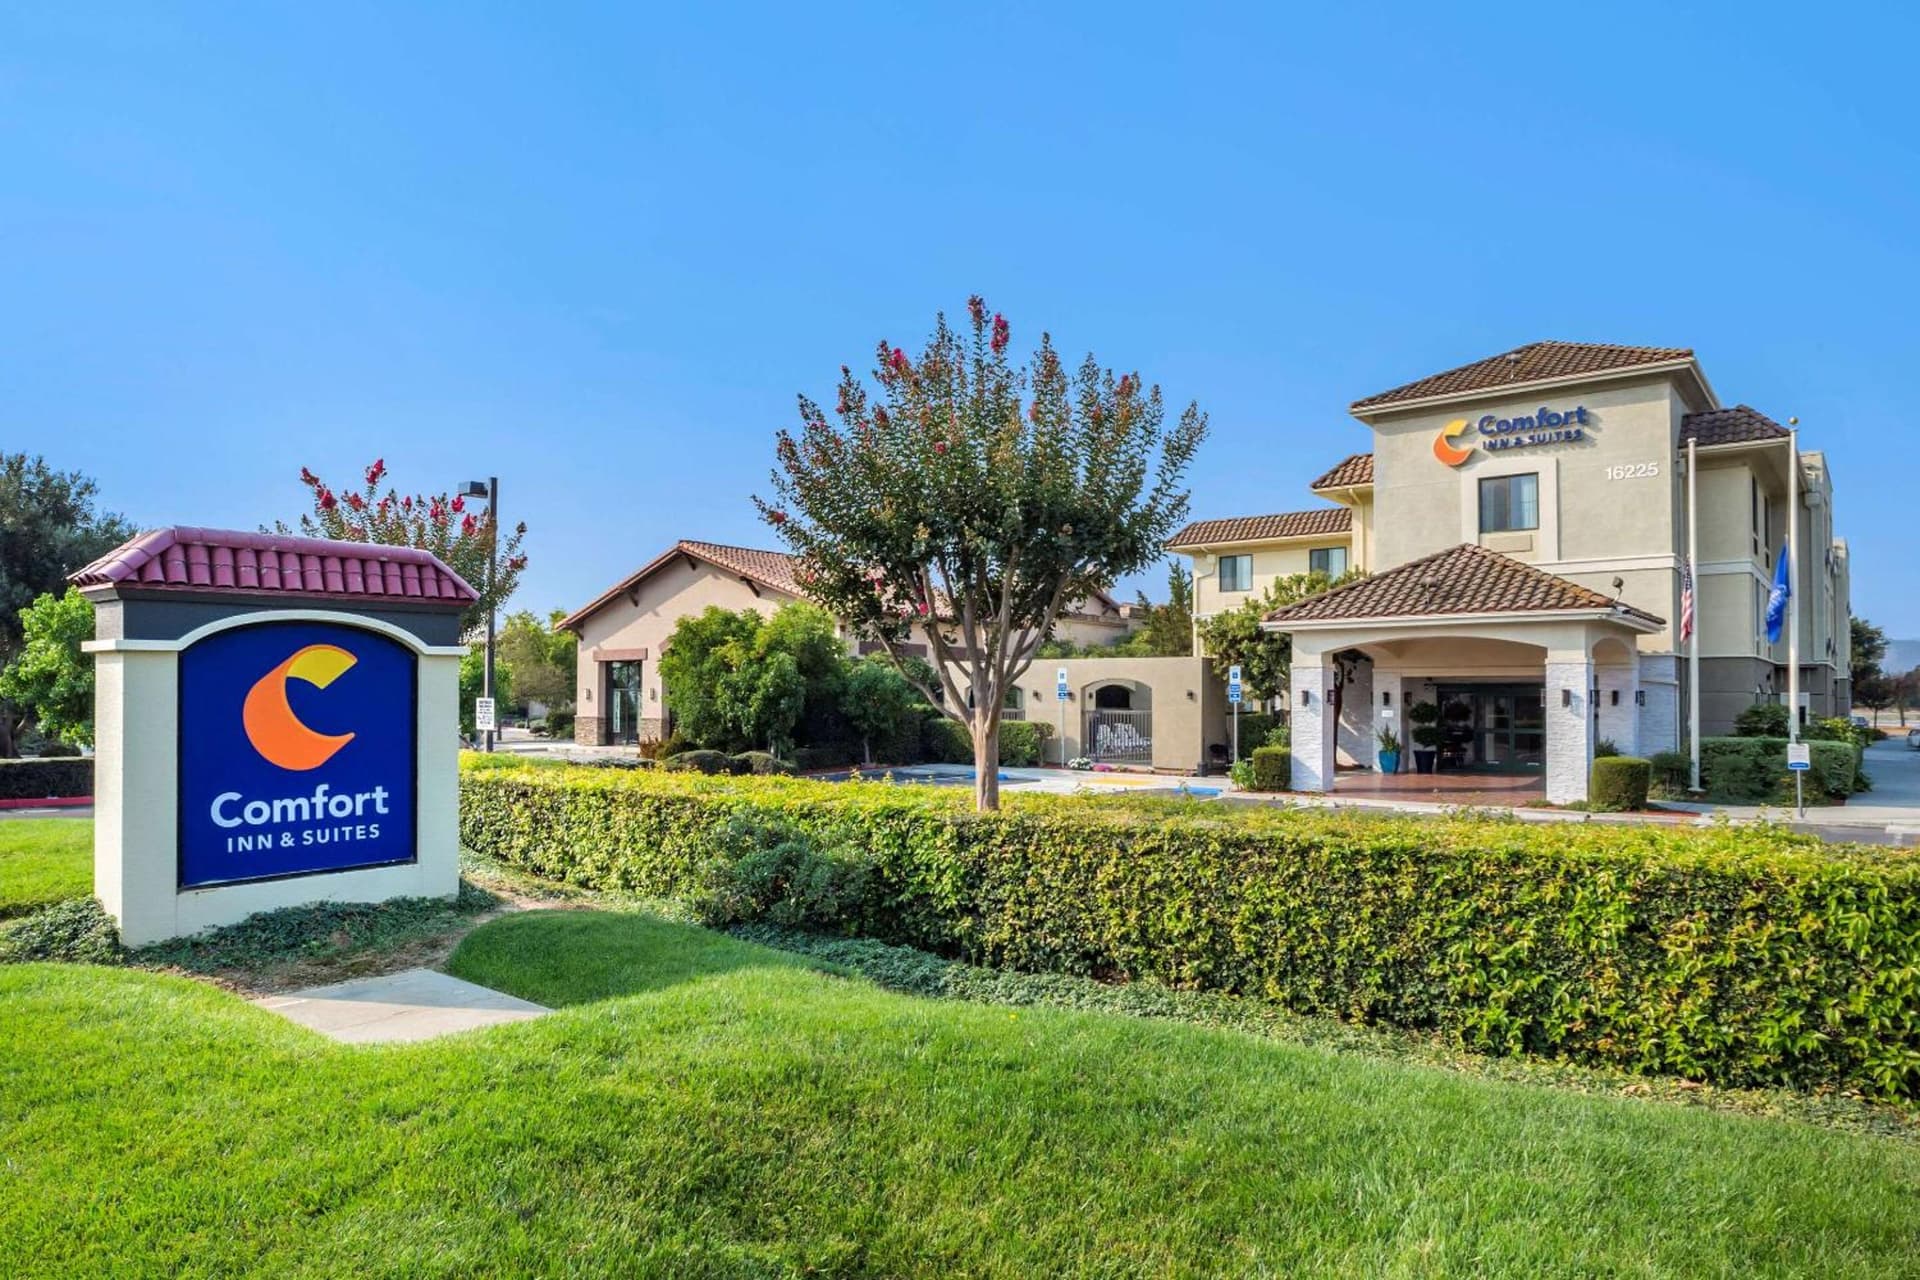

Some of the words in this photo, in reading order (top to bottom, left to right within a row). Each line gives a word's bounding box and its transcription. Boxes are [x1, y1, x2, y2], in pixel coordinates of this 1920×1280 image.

[1478, 405, 1589, 435] Comfort
[1483, 439, 1509, 450] INN
[1528, 429, 1583, 446] SUITES
[1606, 462, 1658, 480] 16225
[210, 783, 389, 828] Comfort
[227, 834, 273, 853] INN
[280, 832, 295, 847] &
[302, 824, 380, 845] SUITES
